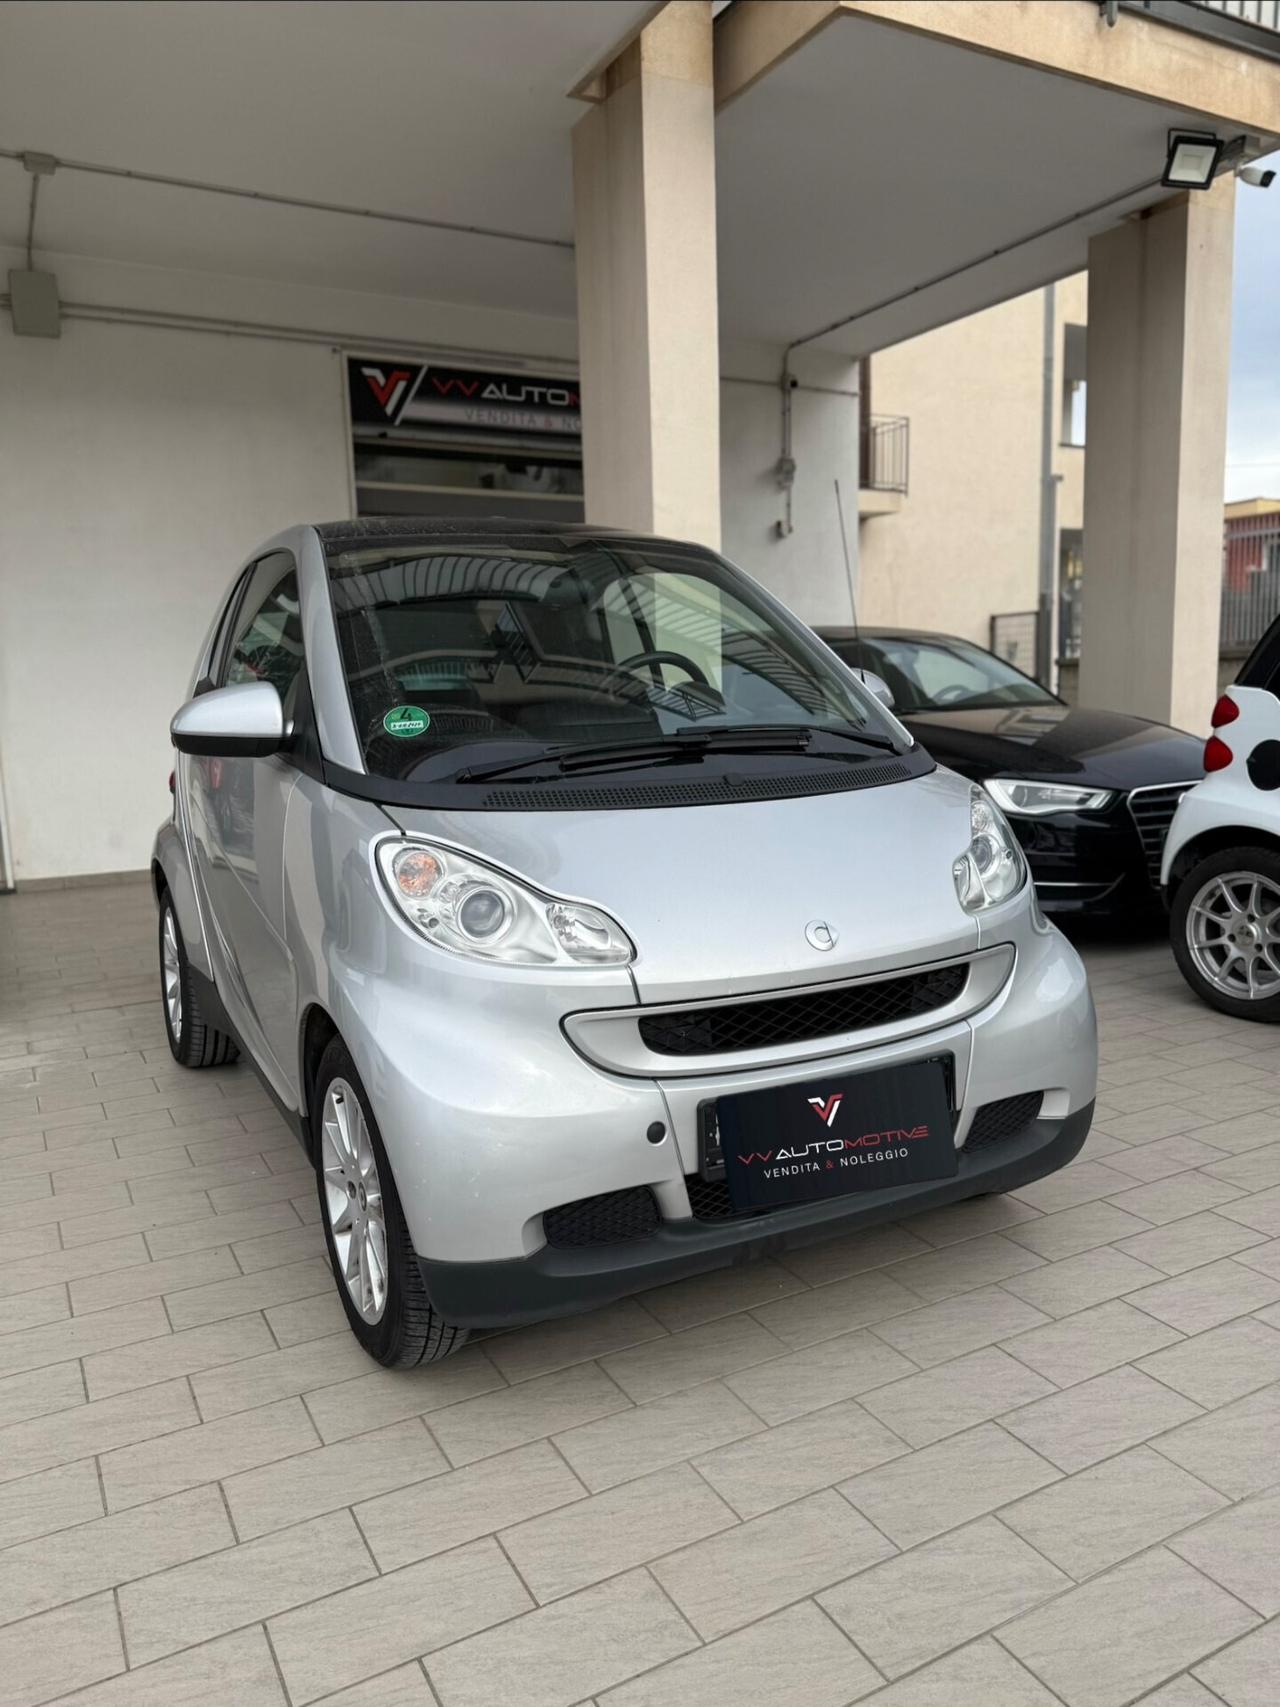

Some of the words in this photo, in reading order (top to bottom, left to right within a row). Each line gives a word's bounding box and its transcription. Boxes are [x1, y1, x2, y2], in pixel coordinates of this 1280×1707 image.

[464, 408, 537, 426] VENDITA
[763, 1162, 821, 1179] VENDITA
[825, 1159, 834, 1170] &
[839, 1147, 909, 1168] NOLEGGIO
